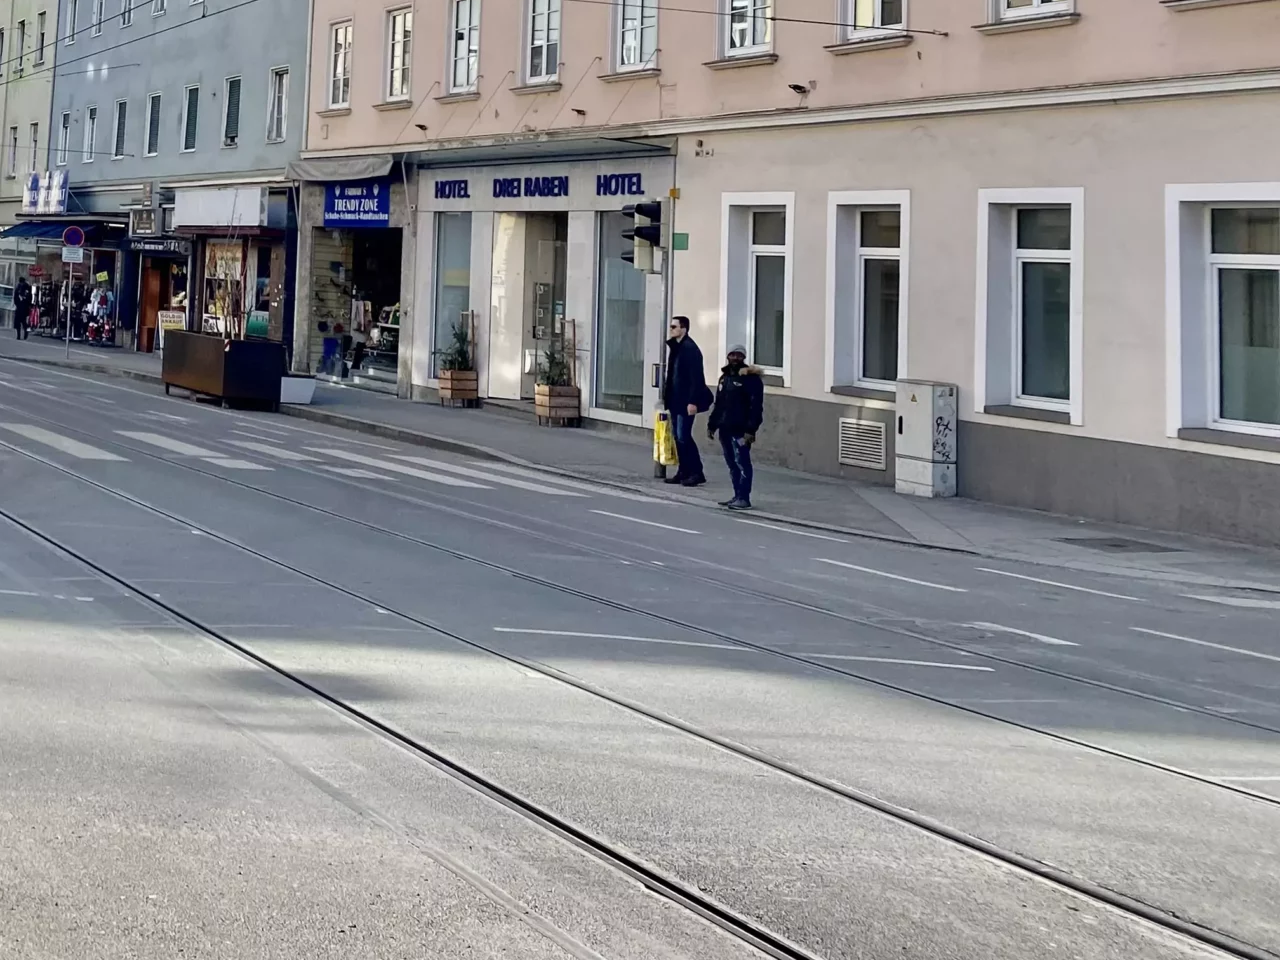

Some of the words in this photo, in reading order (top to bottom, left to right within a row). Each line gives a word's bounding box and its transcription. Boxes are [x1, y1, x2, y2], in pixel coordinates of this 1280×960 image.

[434, 179, 471, 200] HOTEL
[492, 178, 521, 198] DREI
[523, 176, 569, 198] RABEN
[596, 173, 645, 196] HOTEL
[334, 199, 360, 211] TRENDY
[360, 199, 379, 211] ZONE
